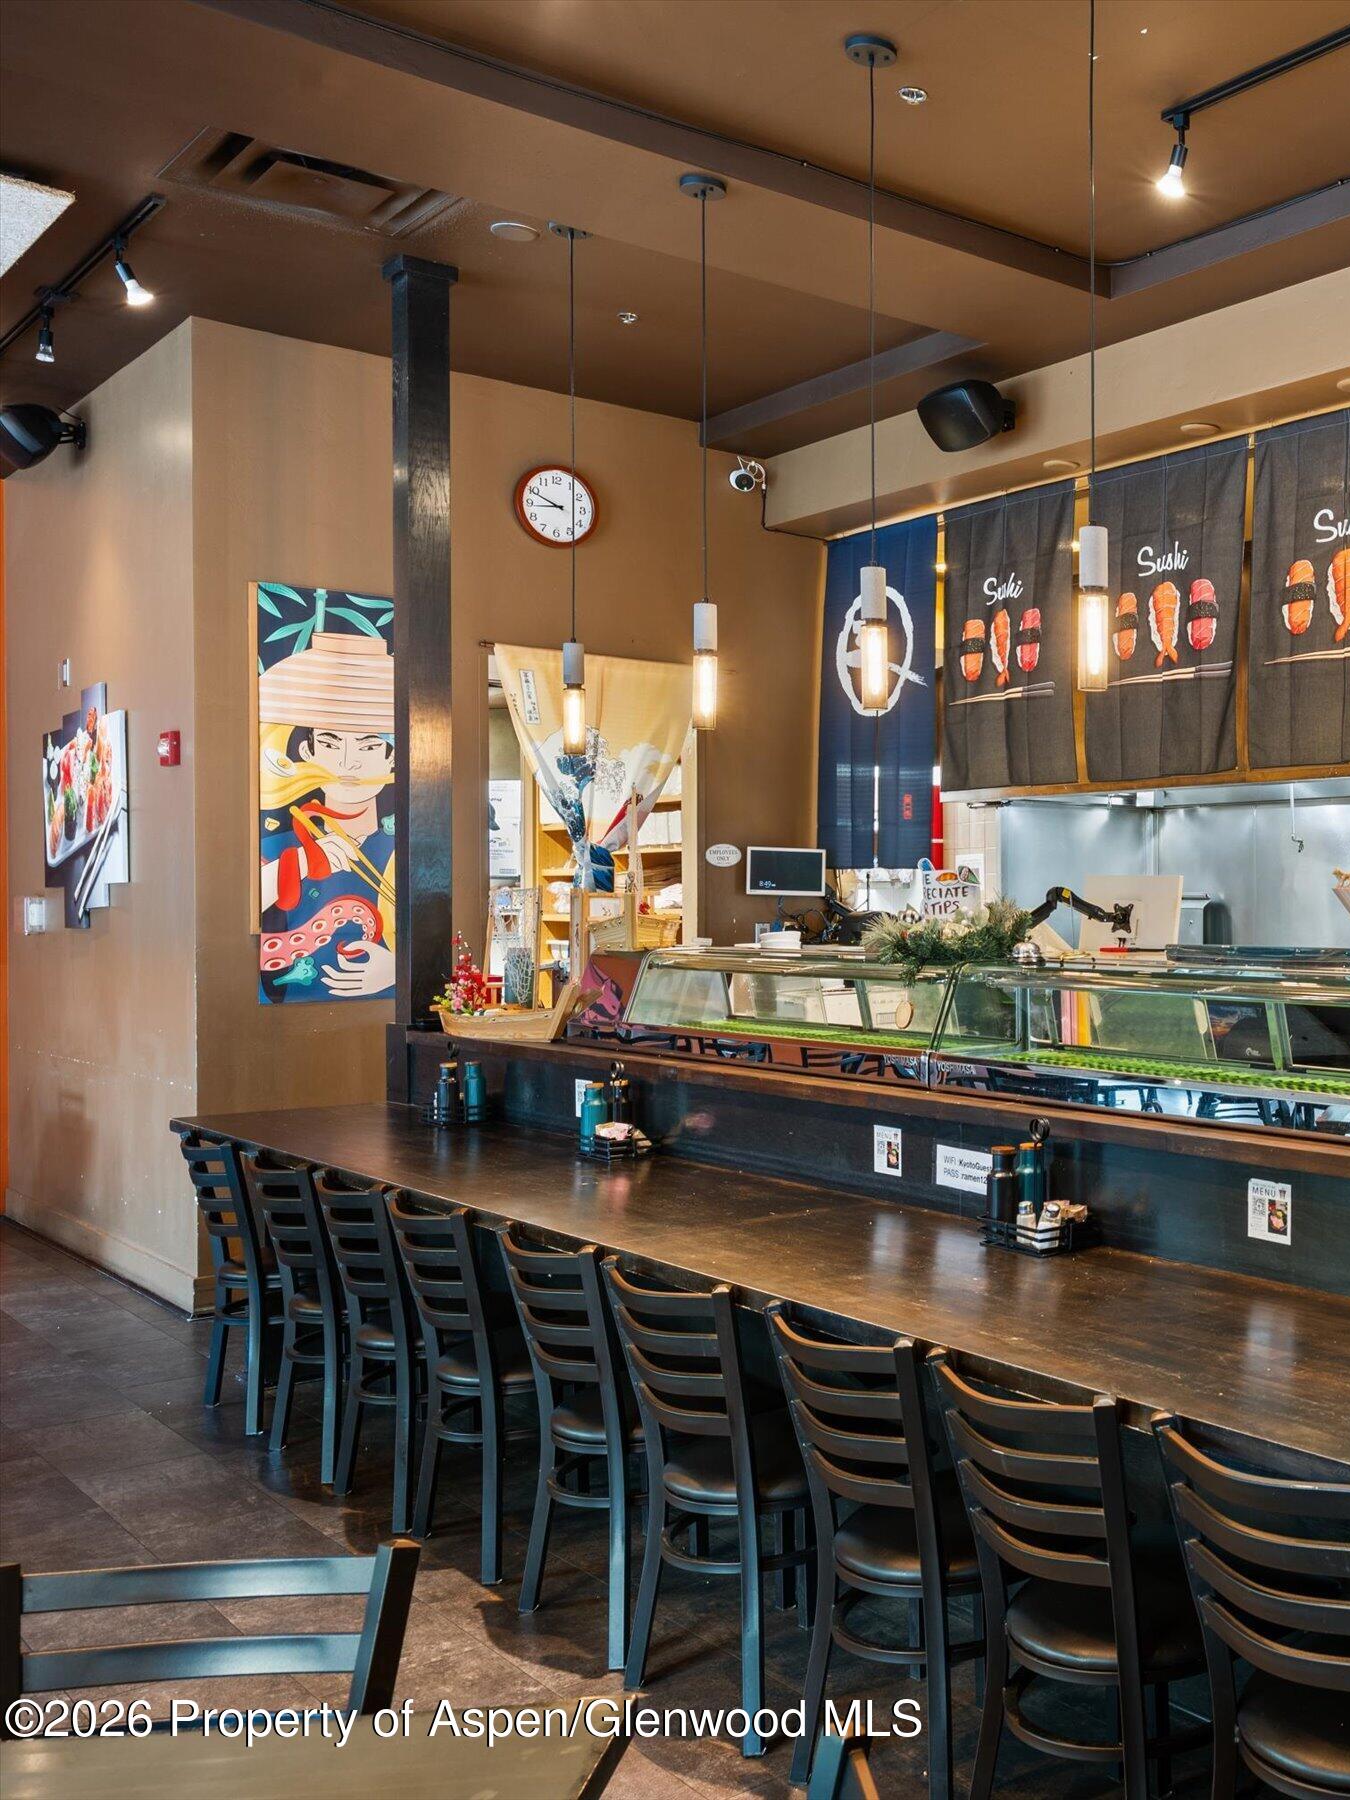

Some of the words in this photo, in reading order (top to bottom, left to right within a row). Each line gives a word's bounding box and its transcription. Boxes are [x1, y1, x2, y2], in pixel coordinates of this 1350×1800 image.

[540, 477, 548, 486] 11
[552, 476, 562, 485] 12
[528, 486, 540, 495] 10
[576, 493, 583, 501] 2
[526, 498, 534, 507] 9
[580, 506, 586, 515] 3
[530, 513, 537, 521] 8
[540, 524, 547, 532] 7
[576, 520, 583, 528] 4
[553, 528, 560, 537] 6
[566, 527, 573, 536] 5
[1137, 541, 1190, 577] Sushi
[931, 900, 960, 915] TIPS
[1252, 1186, 1276, 1197] MENU
